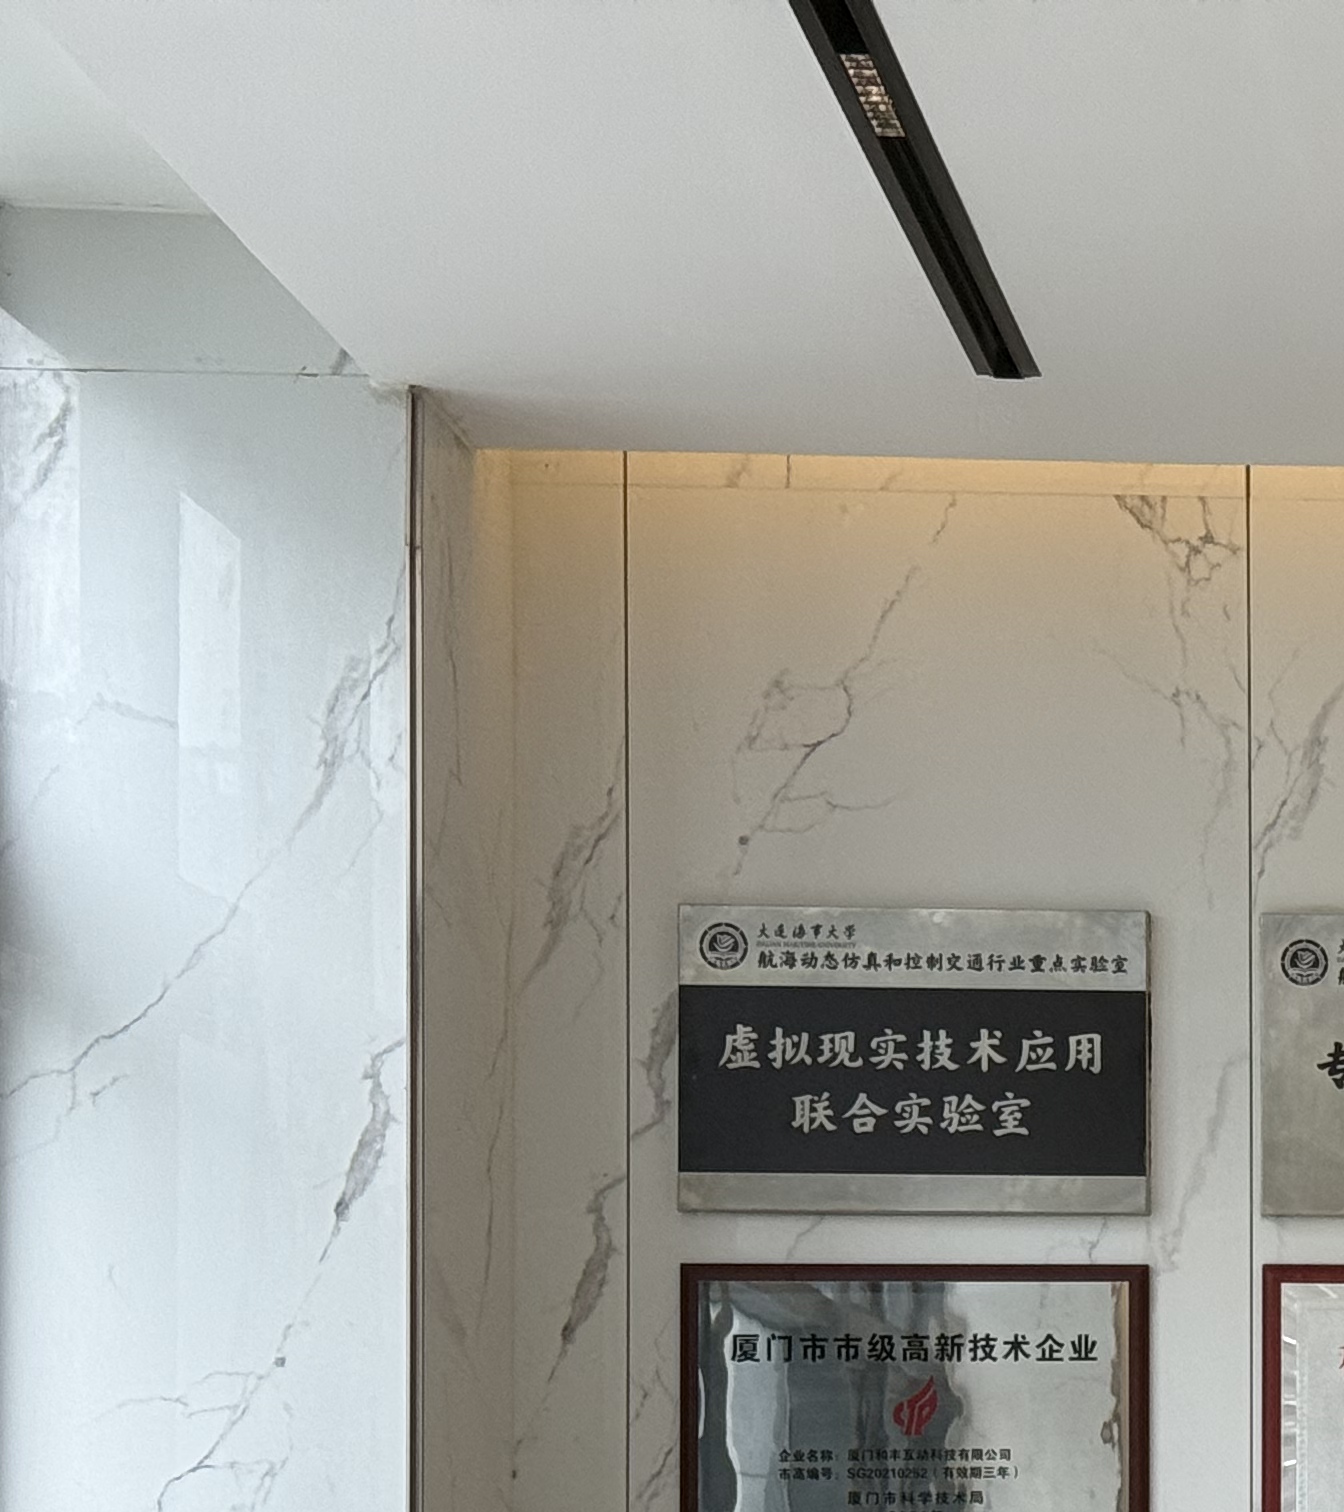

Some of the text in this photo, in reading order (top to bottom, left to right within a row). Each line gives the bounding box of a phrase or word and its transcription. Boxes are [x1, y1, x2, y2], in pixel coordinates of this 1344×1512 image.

[757, 922, 857, 941] 大连海事大学
[757, 949, 1130, 975] 航海动态仿真和控制交通行业重点实验室
[719, 1023, 1103, 1075] 虚拟现实技术应用
[791, 1091, 1032, 1137] 联合实验室
[730, 1333, 1098, 1364] 厦门市市级高新技术企业
[847, 1490, 984, 1507] 厦门市科学技术局
